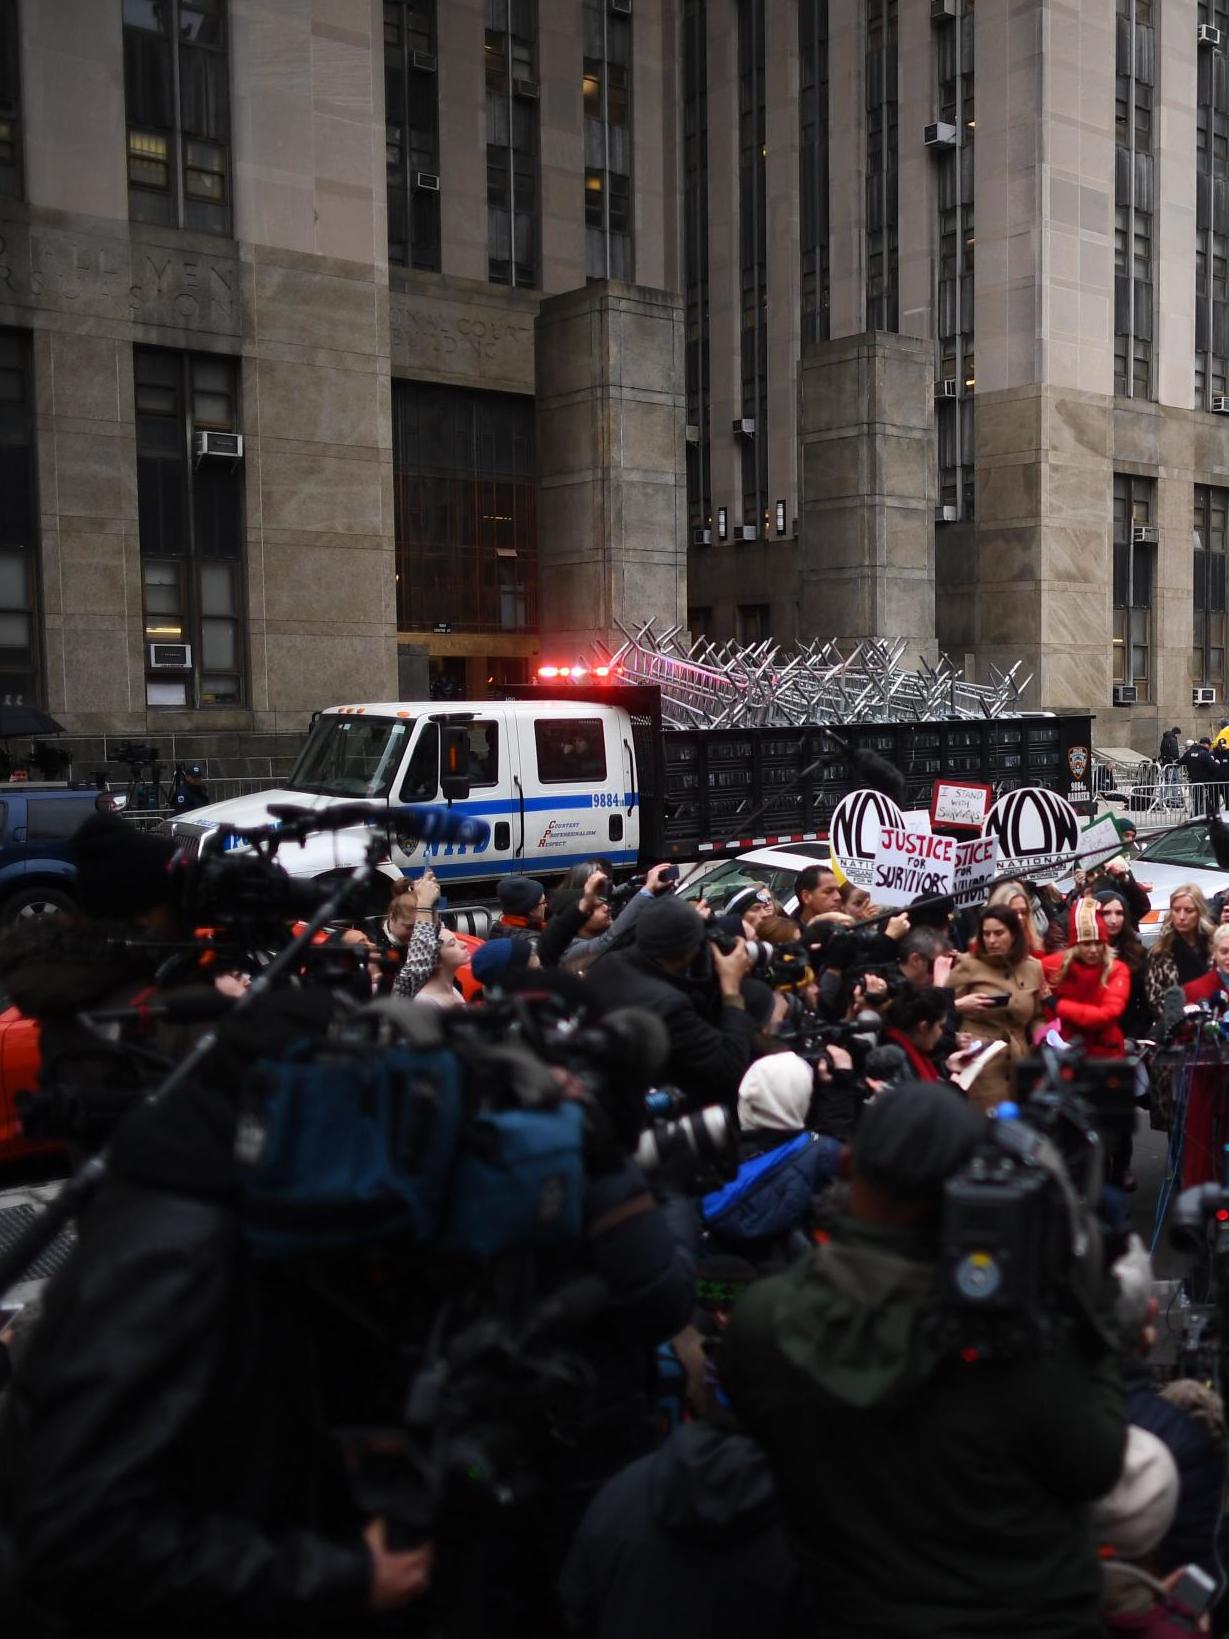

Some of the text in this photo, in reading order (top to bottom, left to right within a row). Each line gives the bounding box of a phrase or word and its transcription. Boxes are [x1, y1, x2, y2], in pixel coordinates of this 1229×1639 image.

[593, 793, 619, 808] 9884
[955, 788, 983, 800] STAND
[951, 798, 970, 808] WITH
[985, 789, 1079, 859] NOW
[881, 829, 953, 862] JUSTICE
[907, 856, 926, 869] FOR
[875, 864, 949, 896] SURVIVORS
